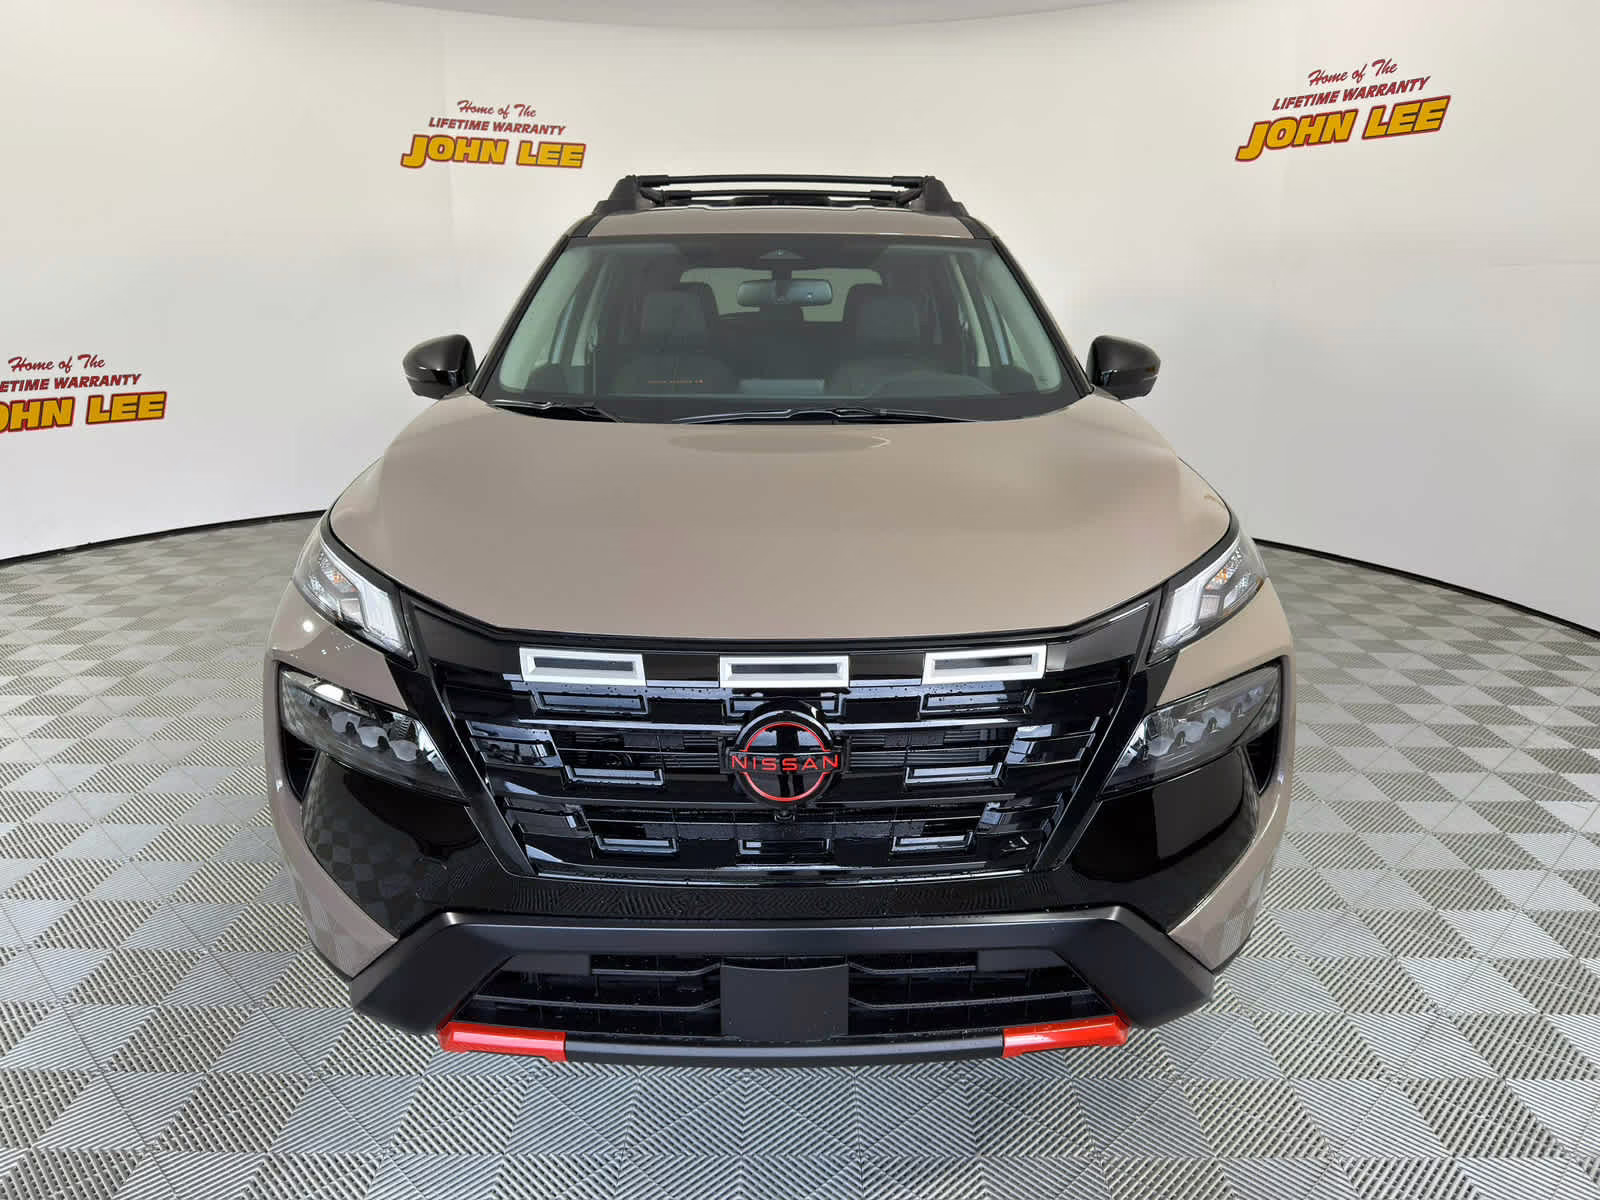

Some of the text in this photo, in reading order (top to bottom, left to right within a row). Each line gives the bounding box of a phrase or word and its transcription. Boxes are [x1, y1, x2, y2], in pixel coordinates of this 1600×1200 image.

[1308, 58, 1398, 87] Home of The
[1272, 76, 1431, 111] LIFETIME WARRANTY
[457, 99, 537, 119] Home of The
[428, 117, 566, 136] LIFETIME WARRANTY
[1235, 95, 1451, 162] JOHN LEE
[400, 134, 586, 169] JOHN LEE
[8, 353, 105, 374] Home of The
[54, 373, 142, 390] WARRANTY
[86, 391, 168, 425] LEE
[731, 754, 840, 771] NISSAN
